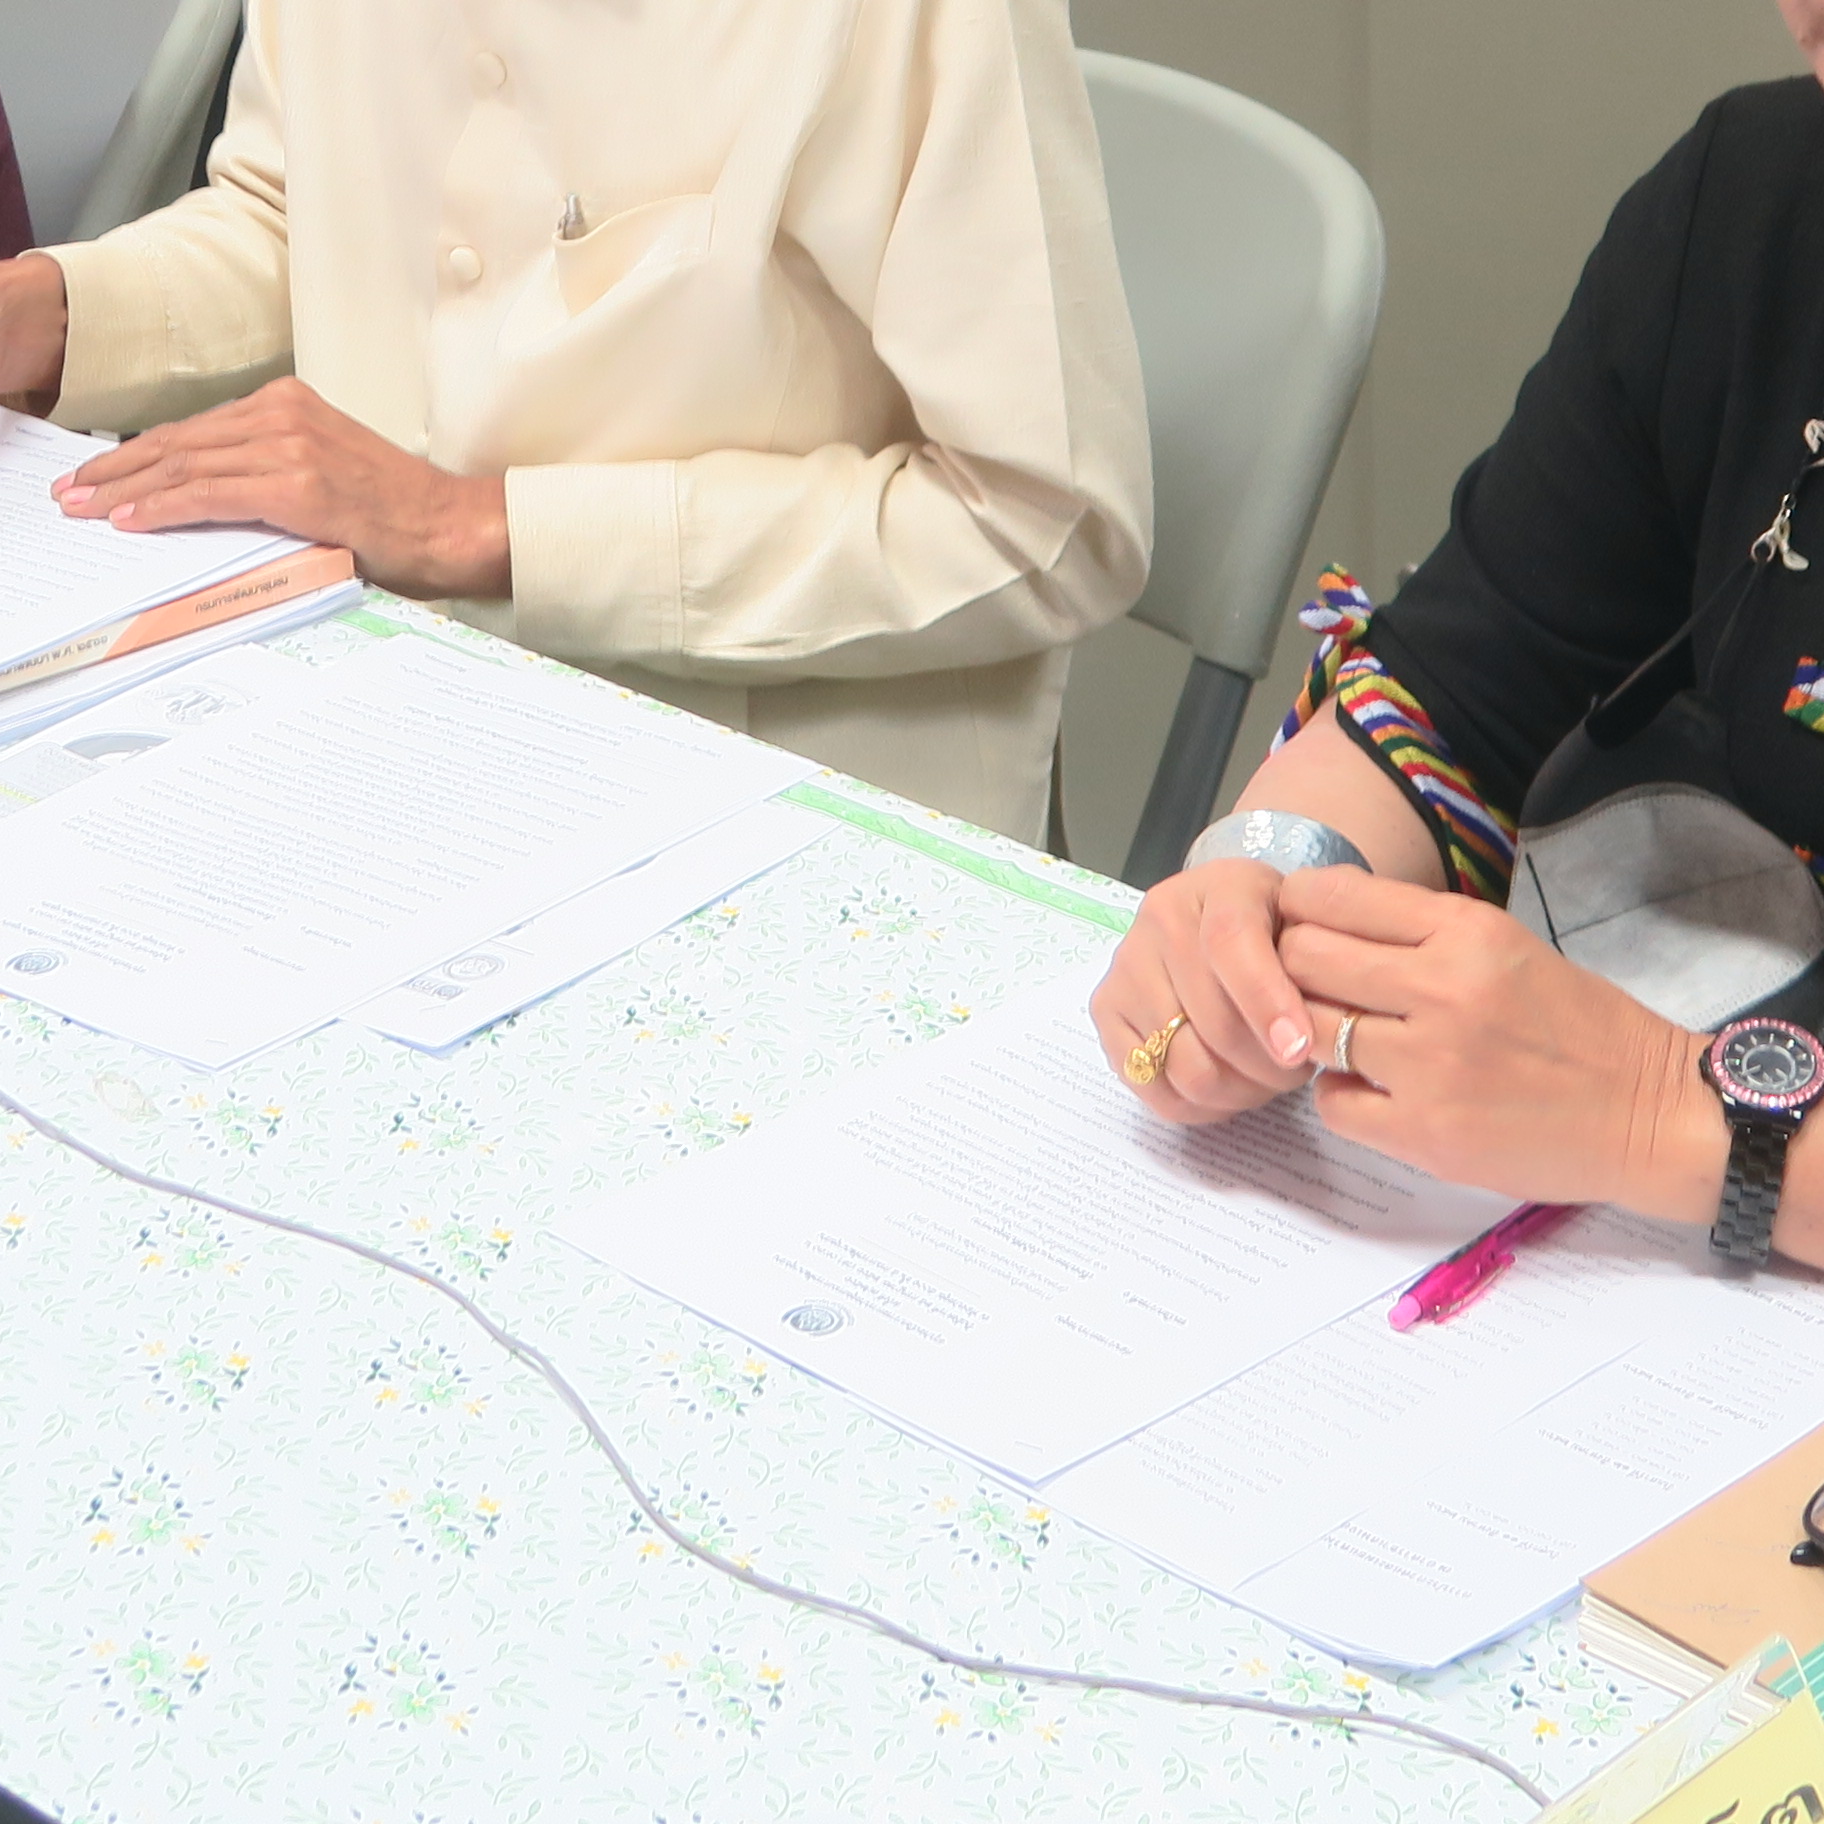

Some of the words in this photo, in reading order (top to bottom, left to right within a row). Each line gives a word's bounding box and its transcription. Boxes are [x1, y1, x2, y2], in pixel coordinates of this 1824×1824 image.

[194, 574, 290, 615] กรมการพัฒนาชุมชน
